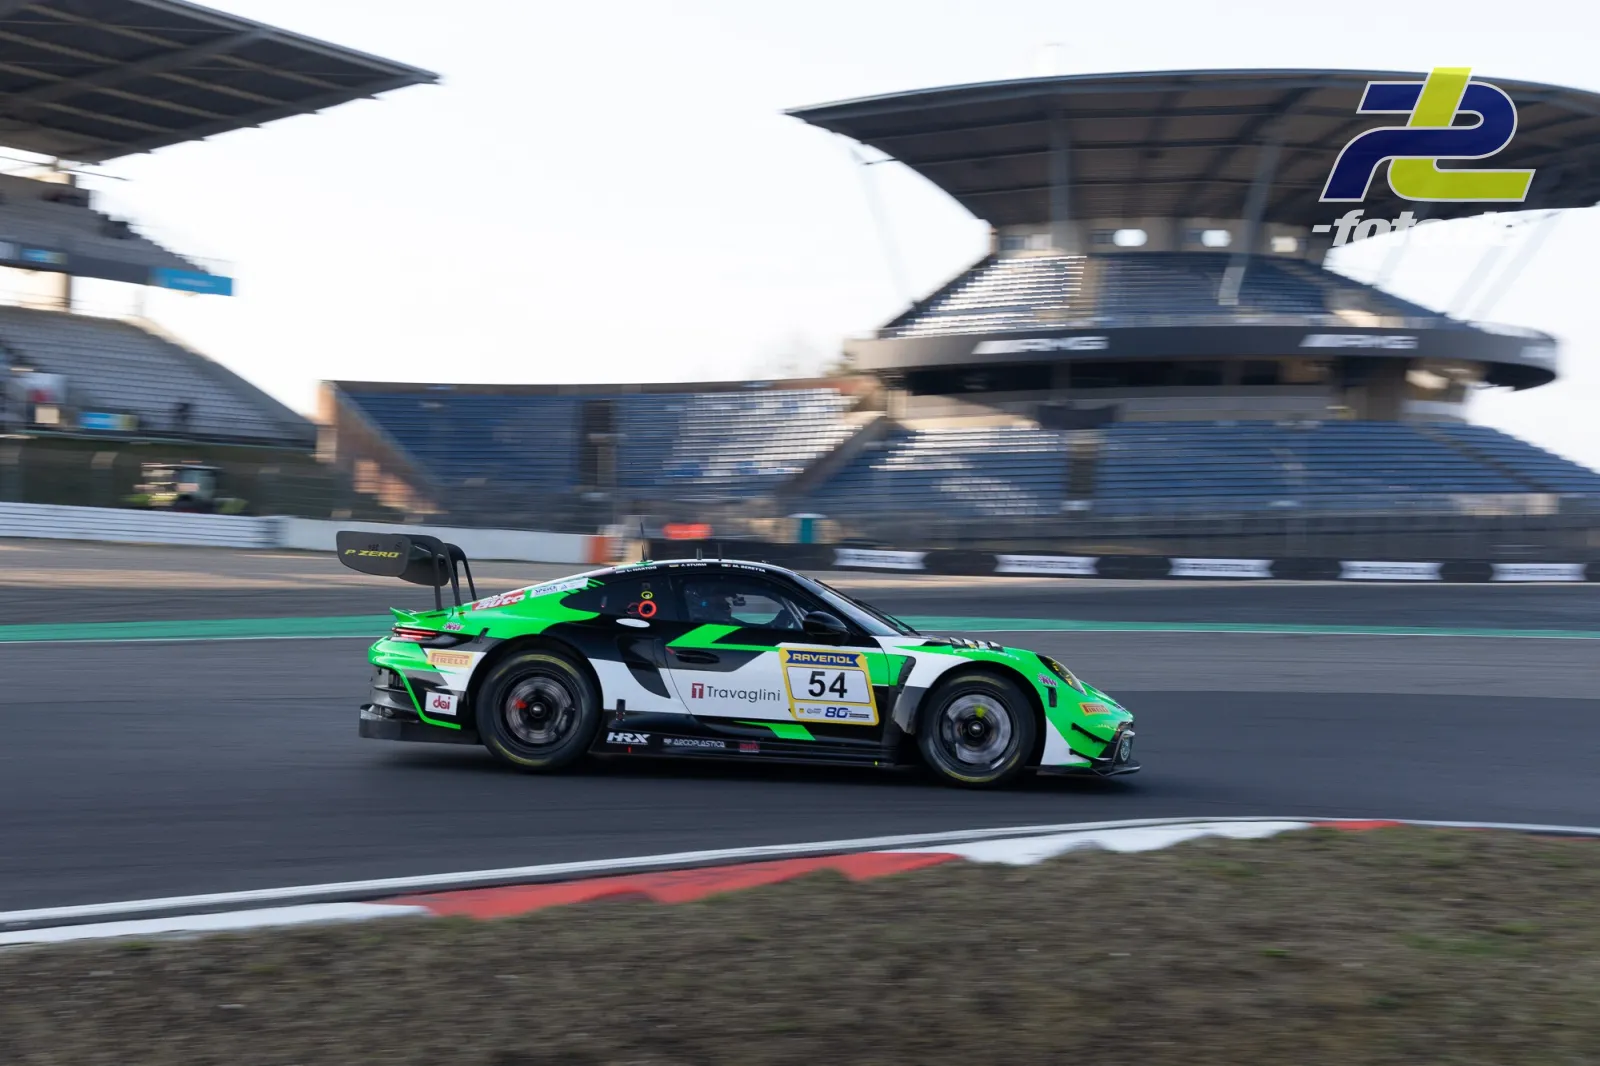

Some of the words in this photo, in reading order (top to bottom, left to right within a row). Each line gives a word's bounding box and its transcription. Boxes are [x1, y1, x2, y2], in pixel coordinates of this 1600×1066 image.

[358, 550, 400, 558] ZERO
[431, 653, 471, 666] PIRELLI
[792, 653, 853, 664] RAVENOL
[808, 670, 847, 698] 54
[707, 686, 780, 704] Travaglini
[607, 732, 651, 743] HRX
